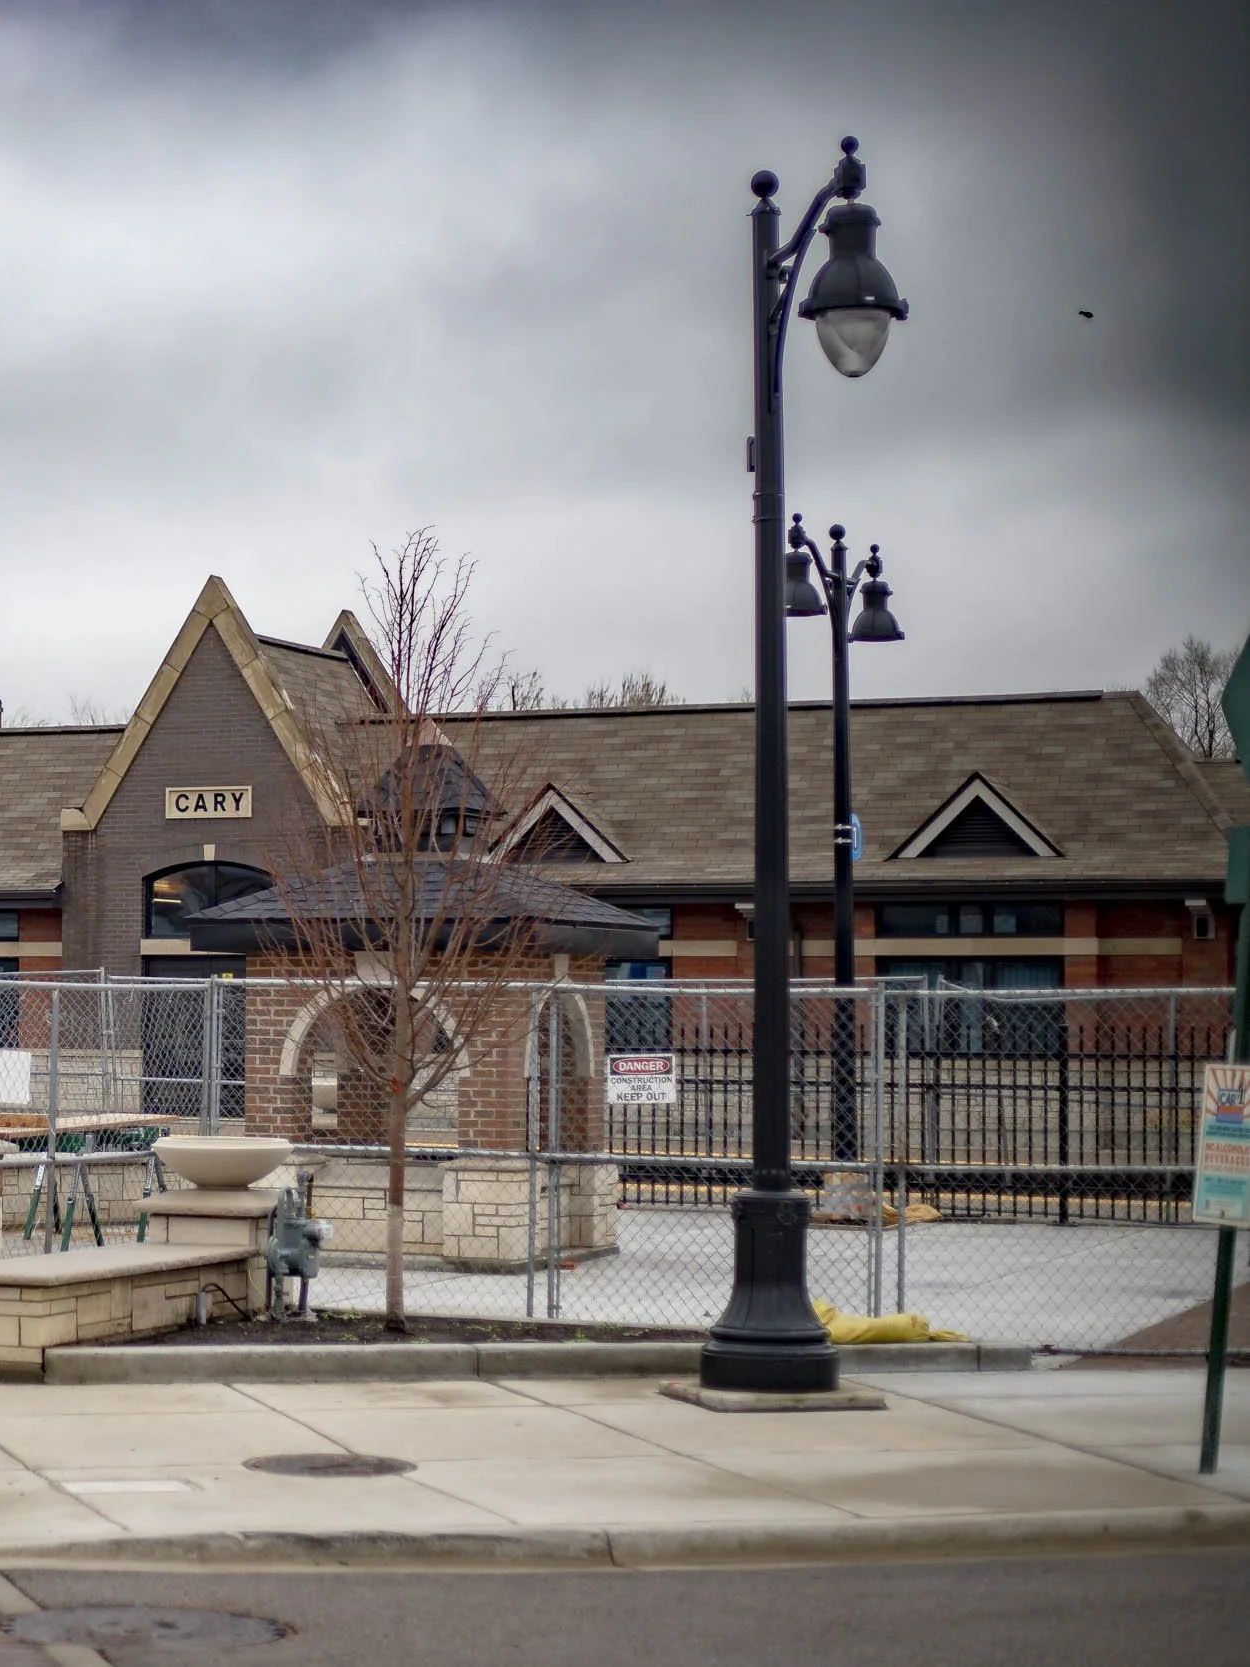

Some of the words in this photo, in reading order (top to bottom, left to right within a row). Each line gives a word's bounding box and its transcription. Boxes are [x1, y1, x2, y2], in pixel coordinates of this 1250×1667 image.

[175, 792, 244, 813] CARY
[619, 1061, 664, 1071] DANGER
[611, 1076, 673, 1085] CONSTRUCTION
[631, 1084, 653, 1092] AREA
[617, 1092, 643, 1101] KEEP
[646, 1092, 667, 1101] OUT
[1206, 1143, 1215, 1151] NO
